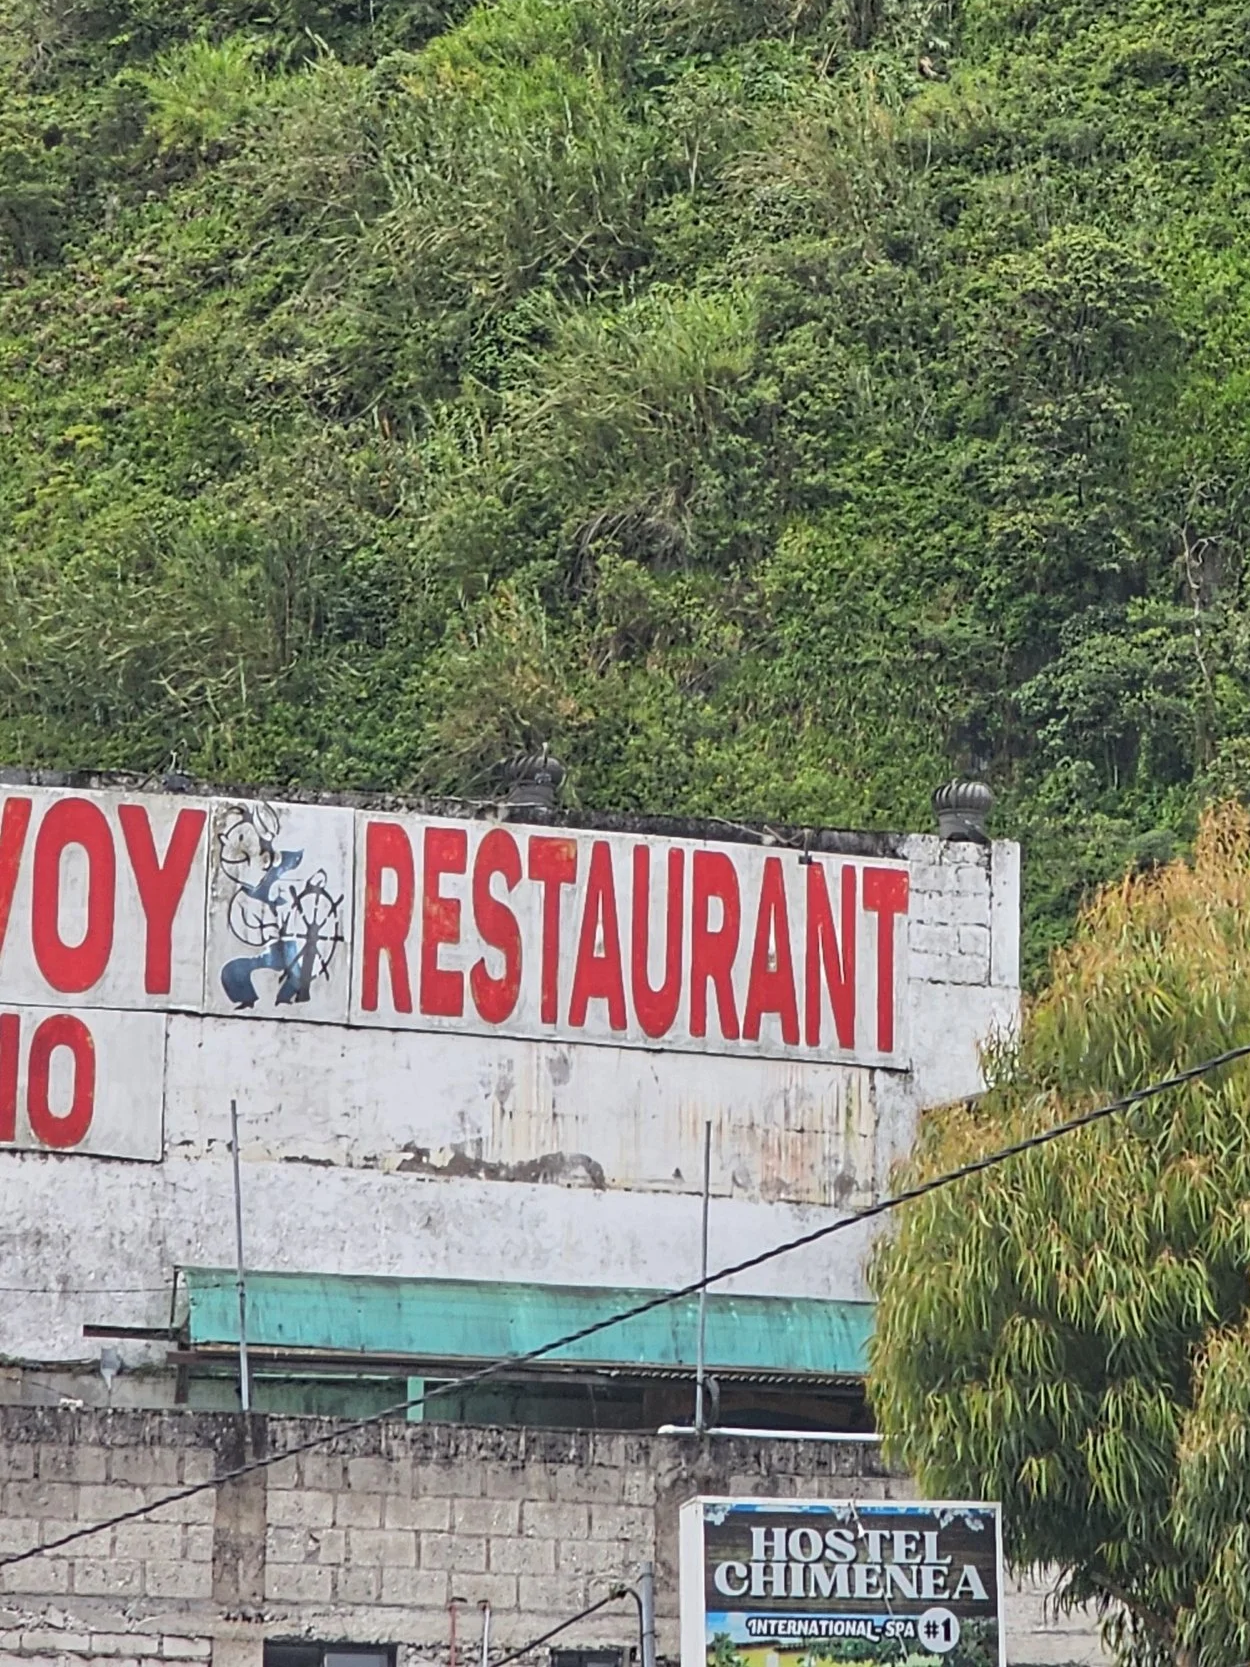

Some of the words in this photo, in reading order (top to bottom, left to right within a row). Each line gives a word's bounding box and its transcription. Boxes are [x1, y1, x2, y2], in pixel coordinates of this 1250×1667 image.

[361, 821, 909, 1053] RESTAURANT
[750, 1527, 952, 1565] HOSTEL
[714, 1561, 989, 1600] CHIMENEA
[923, 1618, 951, 1642] #1
